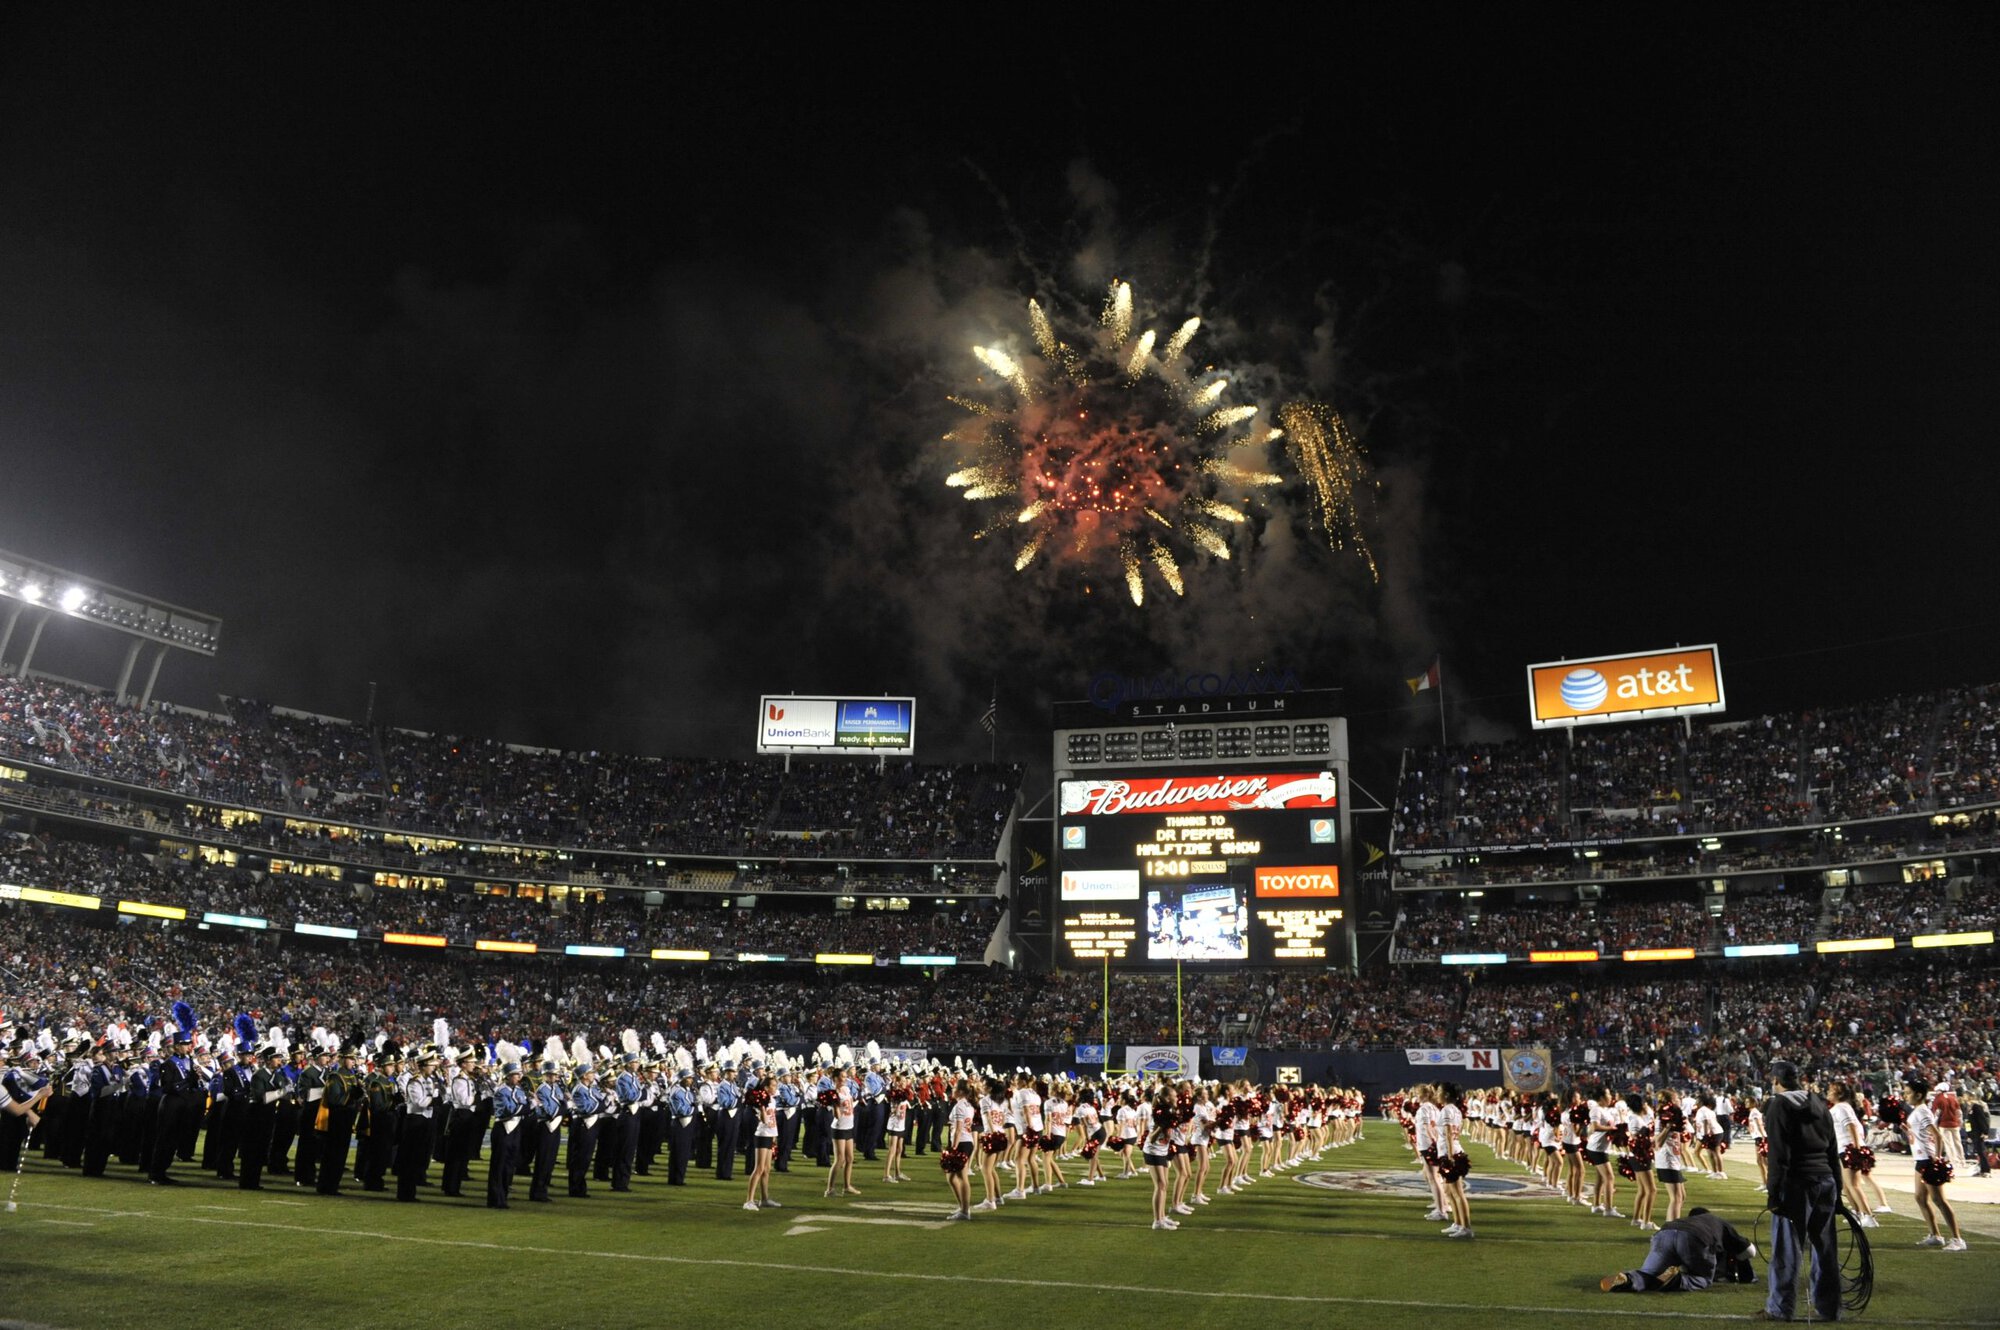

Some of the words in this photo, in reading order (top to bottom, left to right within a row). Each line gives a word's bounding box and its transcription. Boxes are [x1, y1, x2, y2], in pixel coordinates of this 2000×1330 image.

[1616, 663, 1695, 699] at&t
[1088, 670, 1303, 714] QUALCOMM
[1132, 699, 1285, 715] STADIUM
[767, 727, 831, 738] UnionBank
[839, 735, 862, 744] ready.
[879, 735, 906, 743] thrive.
[1086, 776, 1268, 815] Budweiser
[1165, 816, 1207, 827] THANKS
[1209, 815, 1226, 826] TO
[1156, 829, 1176, 841] DR
[1181, 827, 1235, 841] PEPPER
[1136, 843, 1213, 856] HALFTIME
[1220, 841, 1261, 854] SHOW
[1019, 875, 1048, 887] Sprint
[1259, 874, 1335, 890] TOYOTA
[1356, 869, 1389, 882] Sprint
[1471, 1051, 1491, 1068] N
[1279, 1066, 1299, 1084] 25
